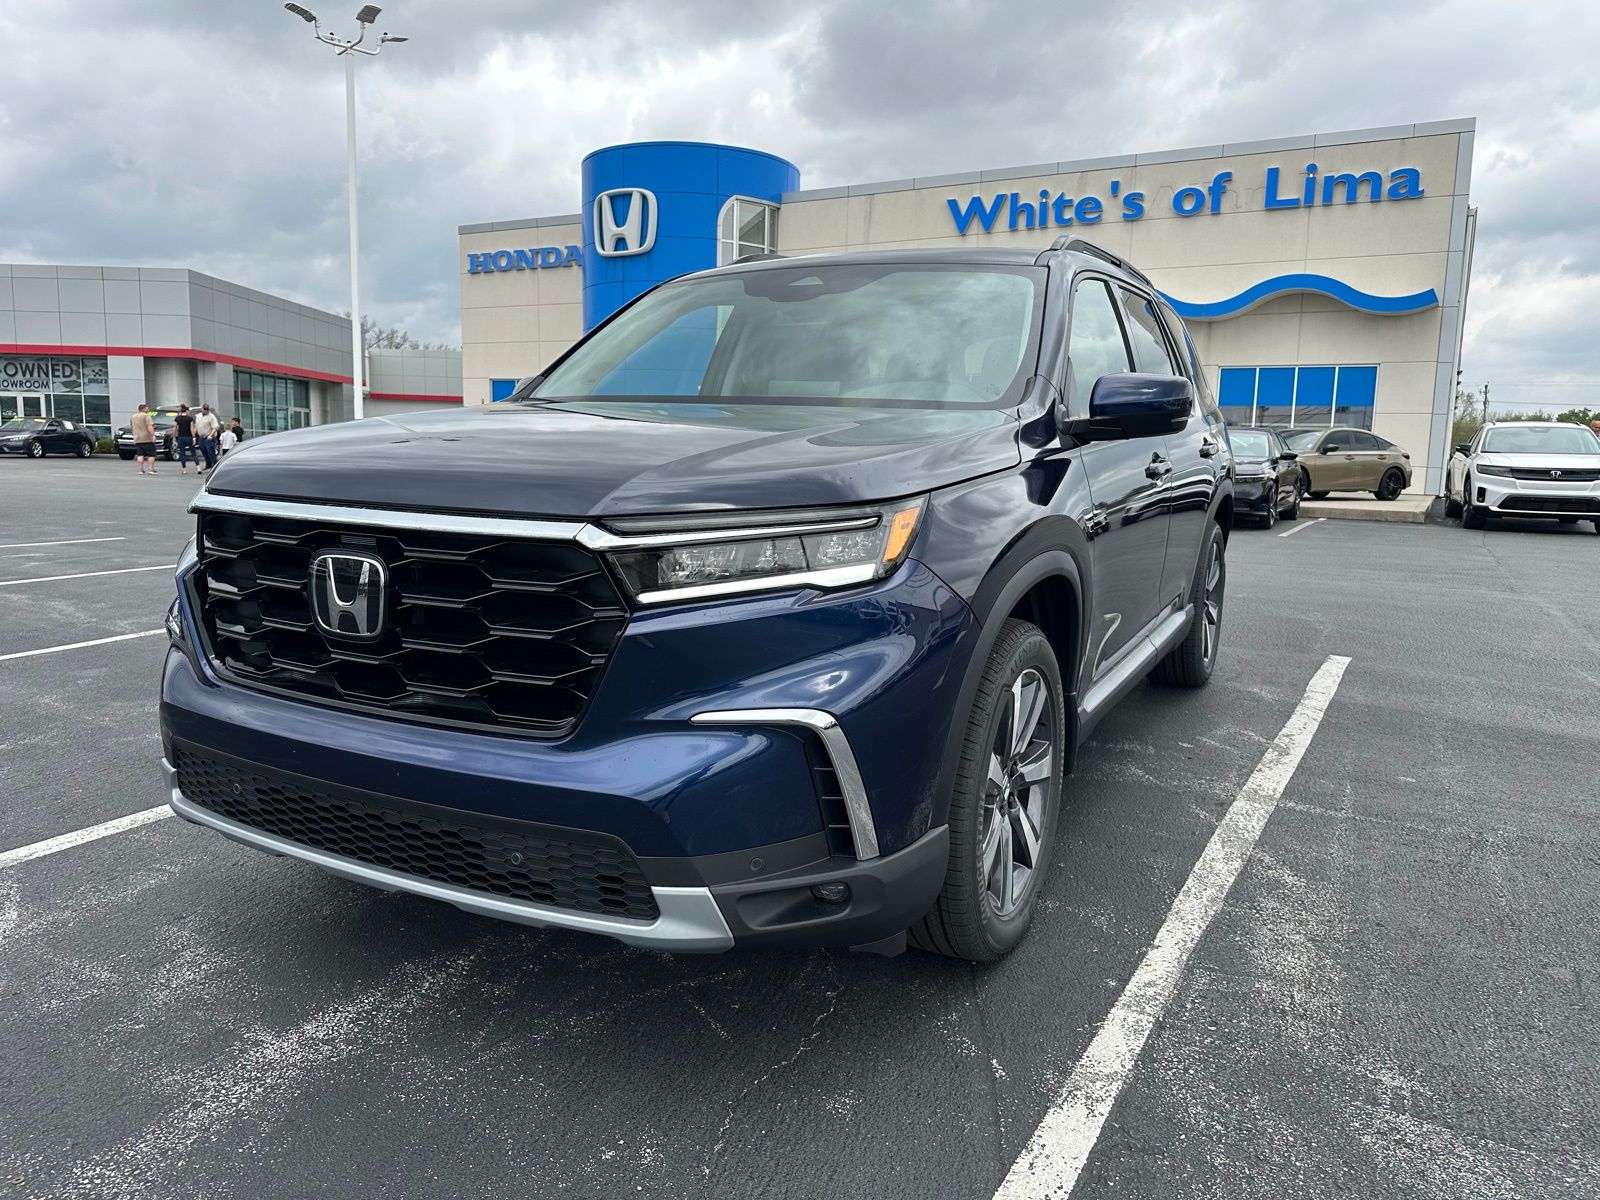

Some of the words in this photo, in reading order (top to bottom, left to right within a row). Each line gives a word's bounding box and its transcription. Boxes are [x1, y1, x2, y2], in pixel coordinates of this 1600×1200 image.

[947, 179, 1145, 236] White's
[1172, 171, 1233, 216] of
[1264, 163, 1425, 210] Lima
[467, 244, 583, 274] HONDA
